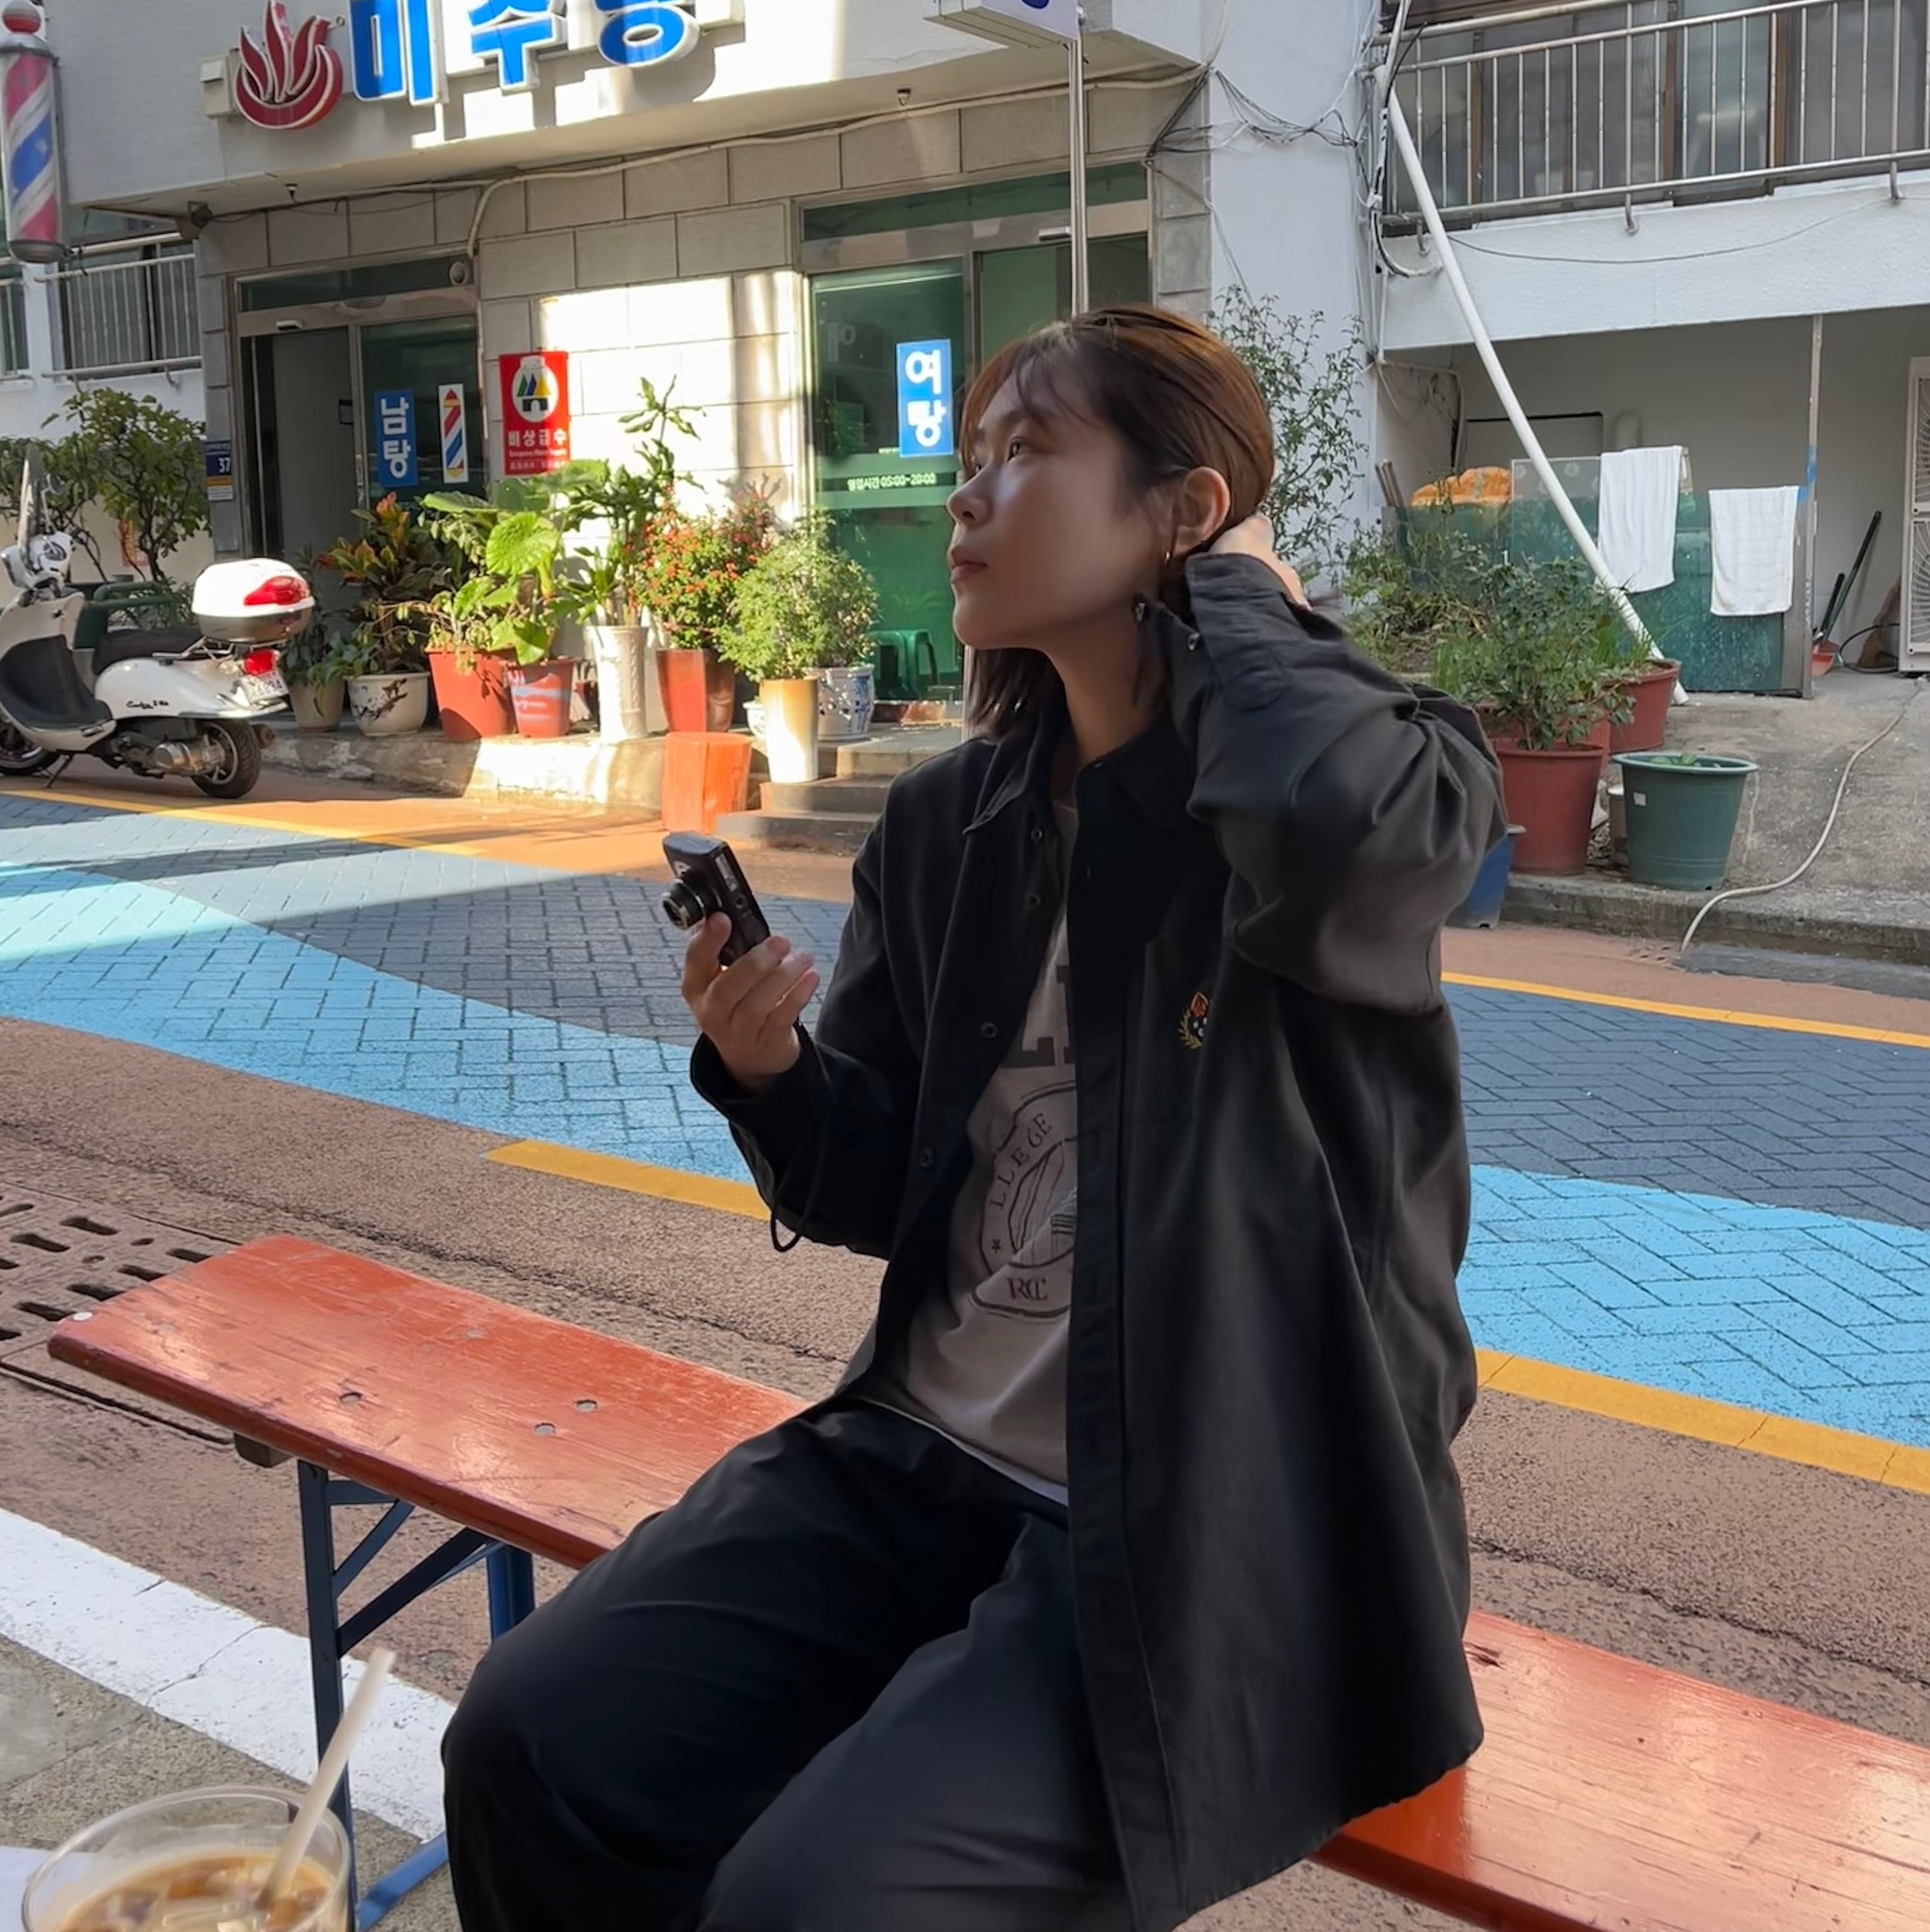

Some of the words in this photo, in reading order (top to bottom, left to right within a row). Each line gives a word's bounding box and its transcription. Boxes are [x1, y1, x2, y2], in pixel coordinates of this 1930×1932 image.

[905, 349, 946, 448] 여탕
[381, 397, 411, 478] 남탕
[508, 428, 567, 447] 비상급수
[218, 457, 231, 473] 37
